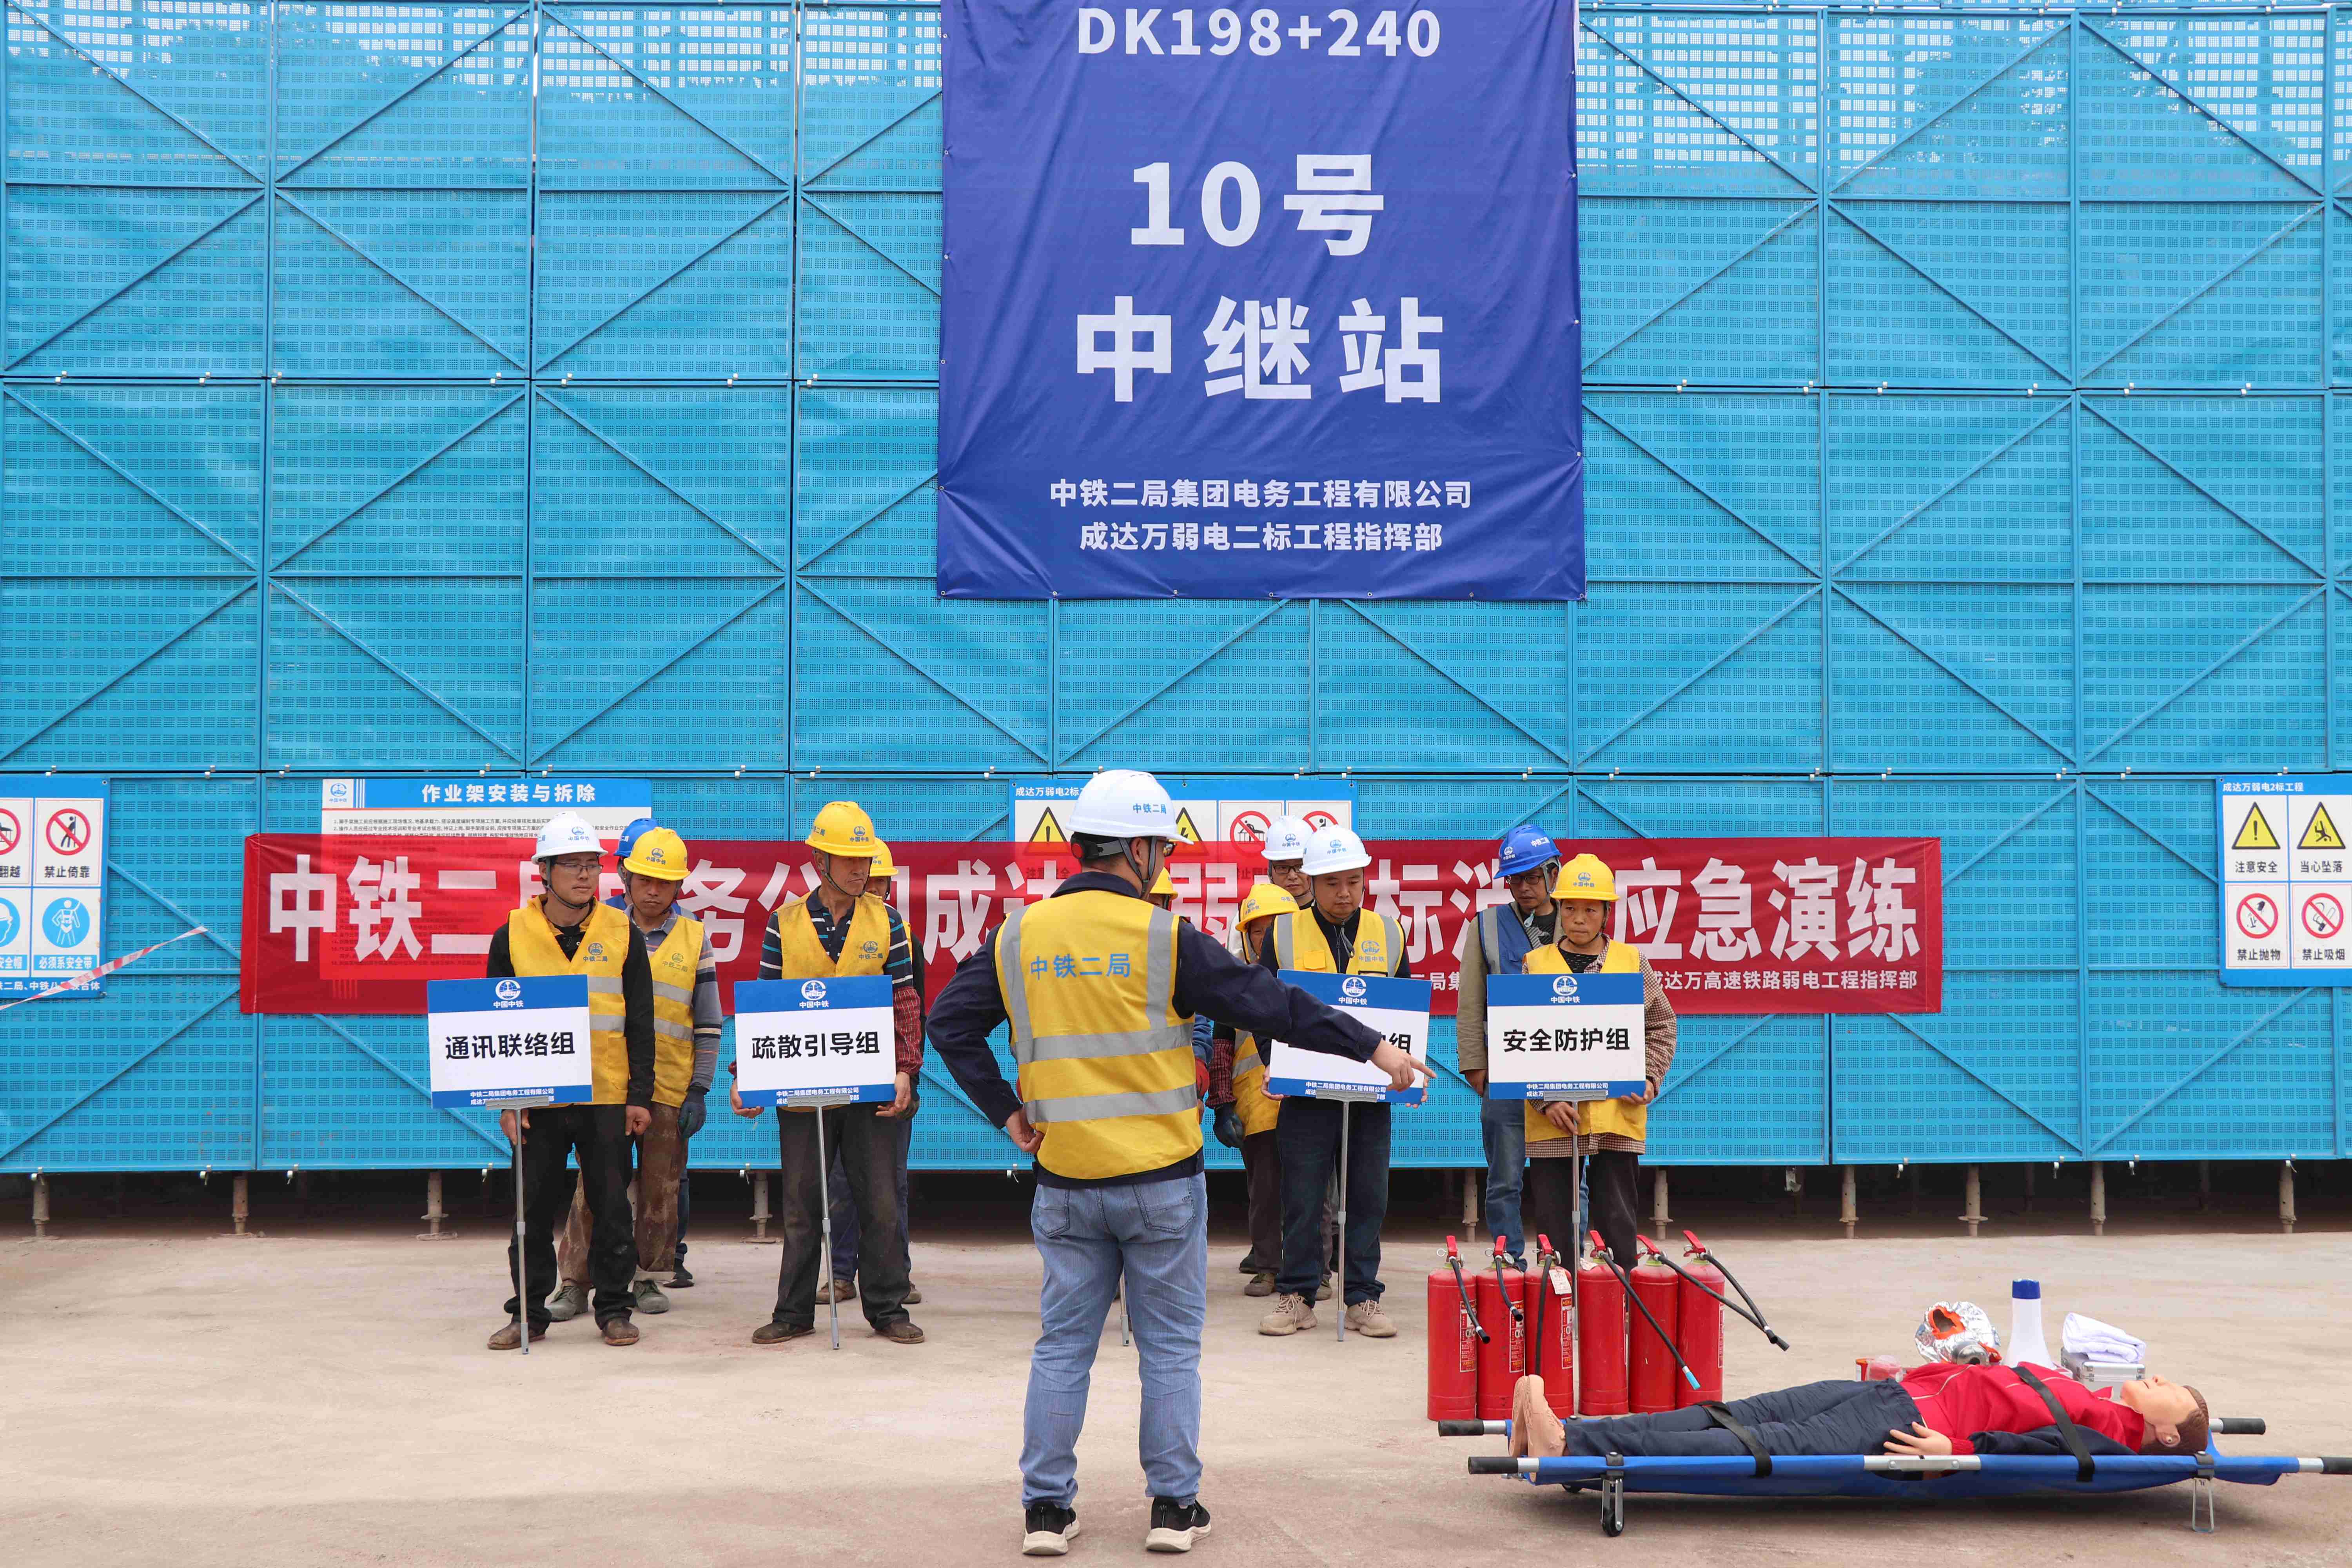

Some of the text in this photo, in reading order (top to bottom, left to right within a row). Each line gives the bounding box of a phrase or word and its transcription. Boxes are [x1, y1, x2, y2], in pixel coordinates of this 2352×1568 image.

[1078, 8, 1441, 57] DK198+240
[1131, 154, 1384, 256] 10号
[1077, 295, 1443, 403] 中继站
[1050, 479, 1471, 508] 中铁二局集团电务工程有限公司
[1080, 521, 1443, 551] 成达万弱电二标工程指挥部
[2223, 782, 2304, 792] 成达万弱电2标工程
[422, 784, 595, 803] 作业架安装与拆除
[1132, 803, 1167, 815] 中铁二局
[44, 866, 90, 878] 禁止倚靠
[2235, 861, 2278, 873] 注意安全
[2301, 860, 2343, 873] 当心坠落
[2237, 949, 2281, 961] 禁止抛物
[2302, 949, 2345, 961] 禁止吸烟
[39, 956, 93, 969] 必须系安全带
[1030, 953, 1131, 980] 中铁二局
[493, 1000, 524, 1008] 中国中铁
[799, 1000, 829, 1009] 中国中铁
[1338, 996, 1368, 1005] 中国中铁
[445, 1032, 575, 1060] 通讯联络组
[751, 1031, 880, 1059] 疏散引导组
[1503, 1027, 1630, 1053] 安全防护组
[470, 1088, 554, 1098] 中铁二局集团电务工程有限公司
[776, 1087, 859, 1097] 中铁二局集团电务工程有限公司
[1306, 1082, 1386, 1093] 中铁二局集团电务工程有限公司
